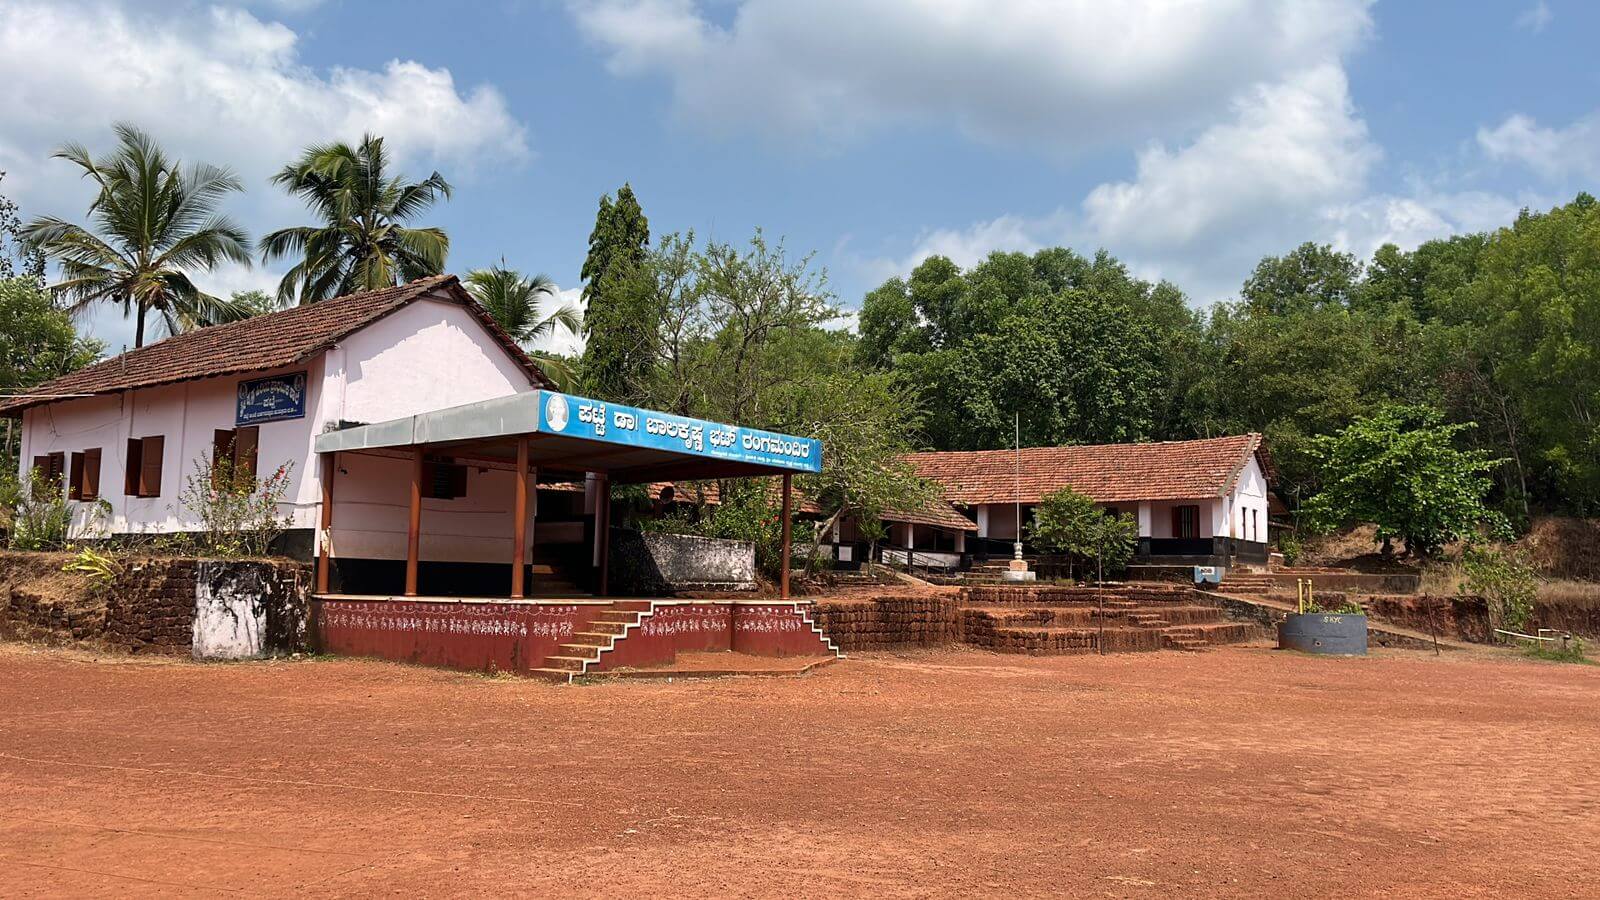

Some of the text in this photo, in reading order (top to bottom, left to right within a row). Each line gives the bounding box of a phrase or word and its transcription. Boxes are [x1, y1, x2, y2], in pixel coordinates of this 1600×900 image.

[578, 403, 606, 436] ಪಟ್ಟೆ
[646, 417, 703, 452] ಬಾಲಕೃಷ್ಣ
[709, 428, 737, 449] ಭಟ್
[742, 432, 810, 459] ರಂಗಮಂದಿರ
